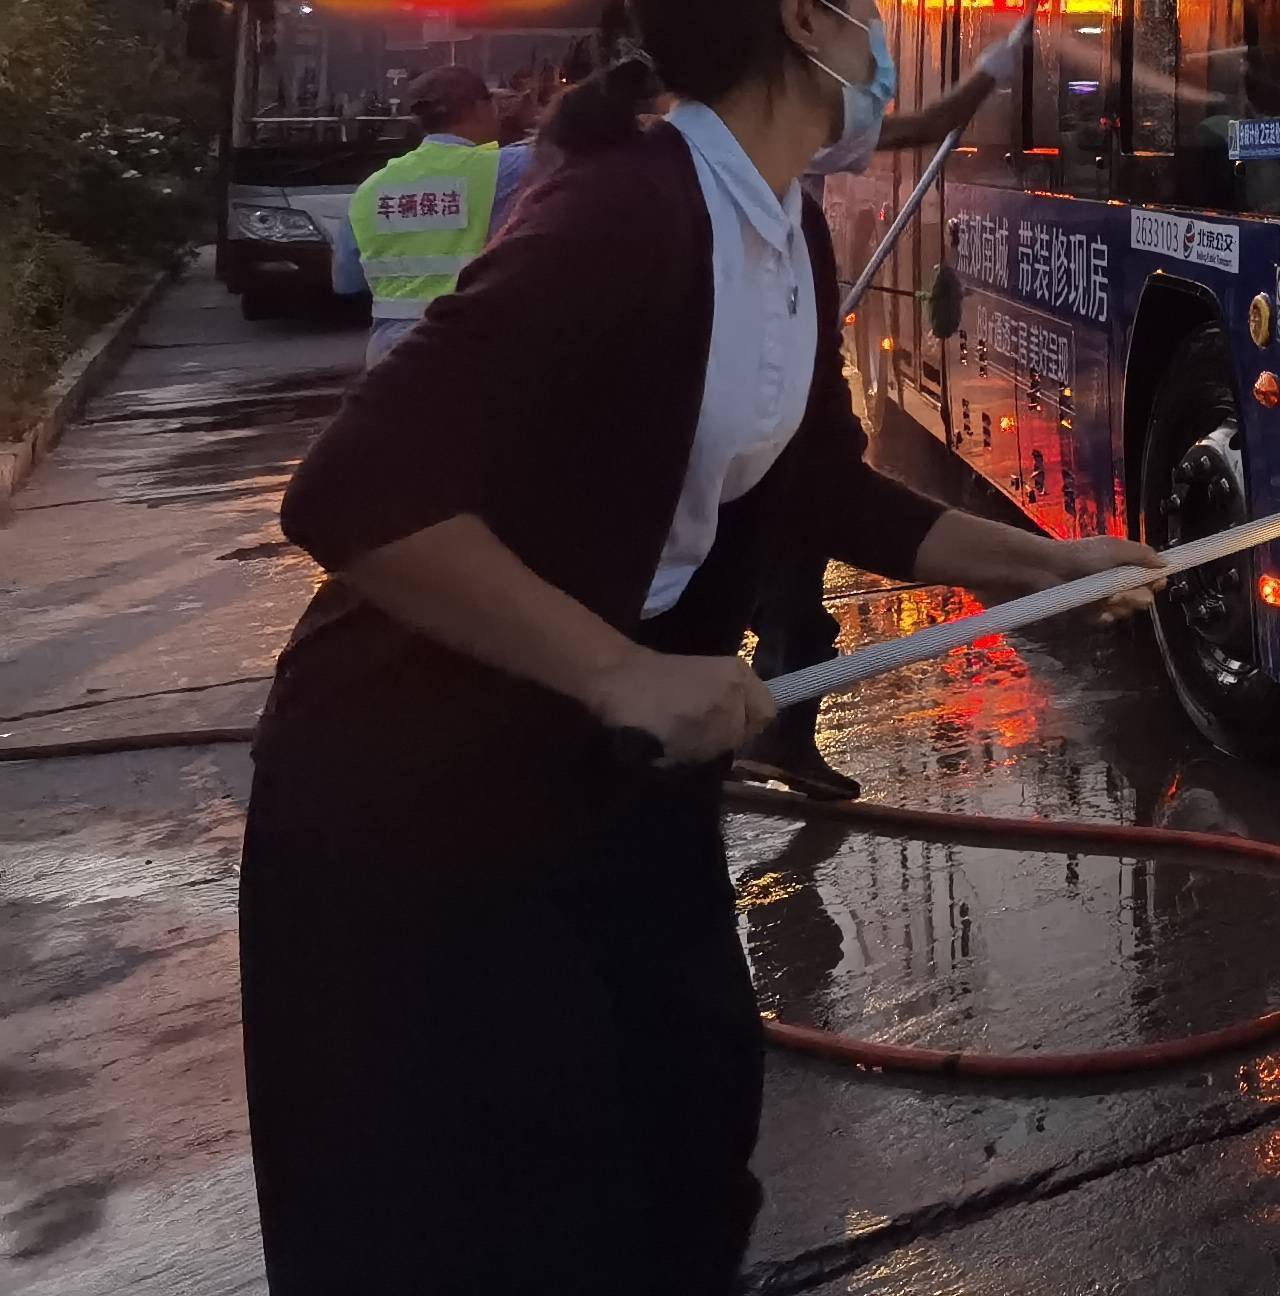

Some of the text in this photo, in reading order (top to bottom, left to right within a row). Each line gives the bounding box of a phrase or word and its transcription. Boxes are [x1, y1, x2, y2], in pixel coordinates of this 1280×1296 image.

[1136, 216, 1233, 253] 2633103 北京公交
[1018, 220, 1108, 322] 带装修现房
[1030, 323, 1069, 386] 美好呈现
